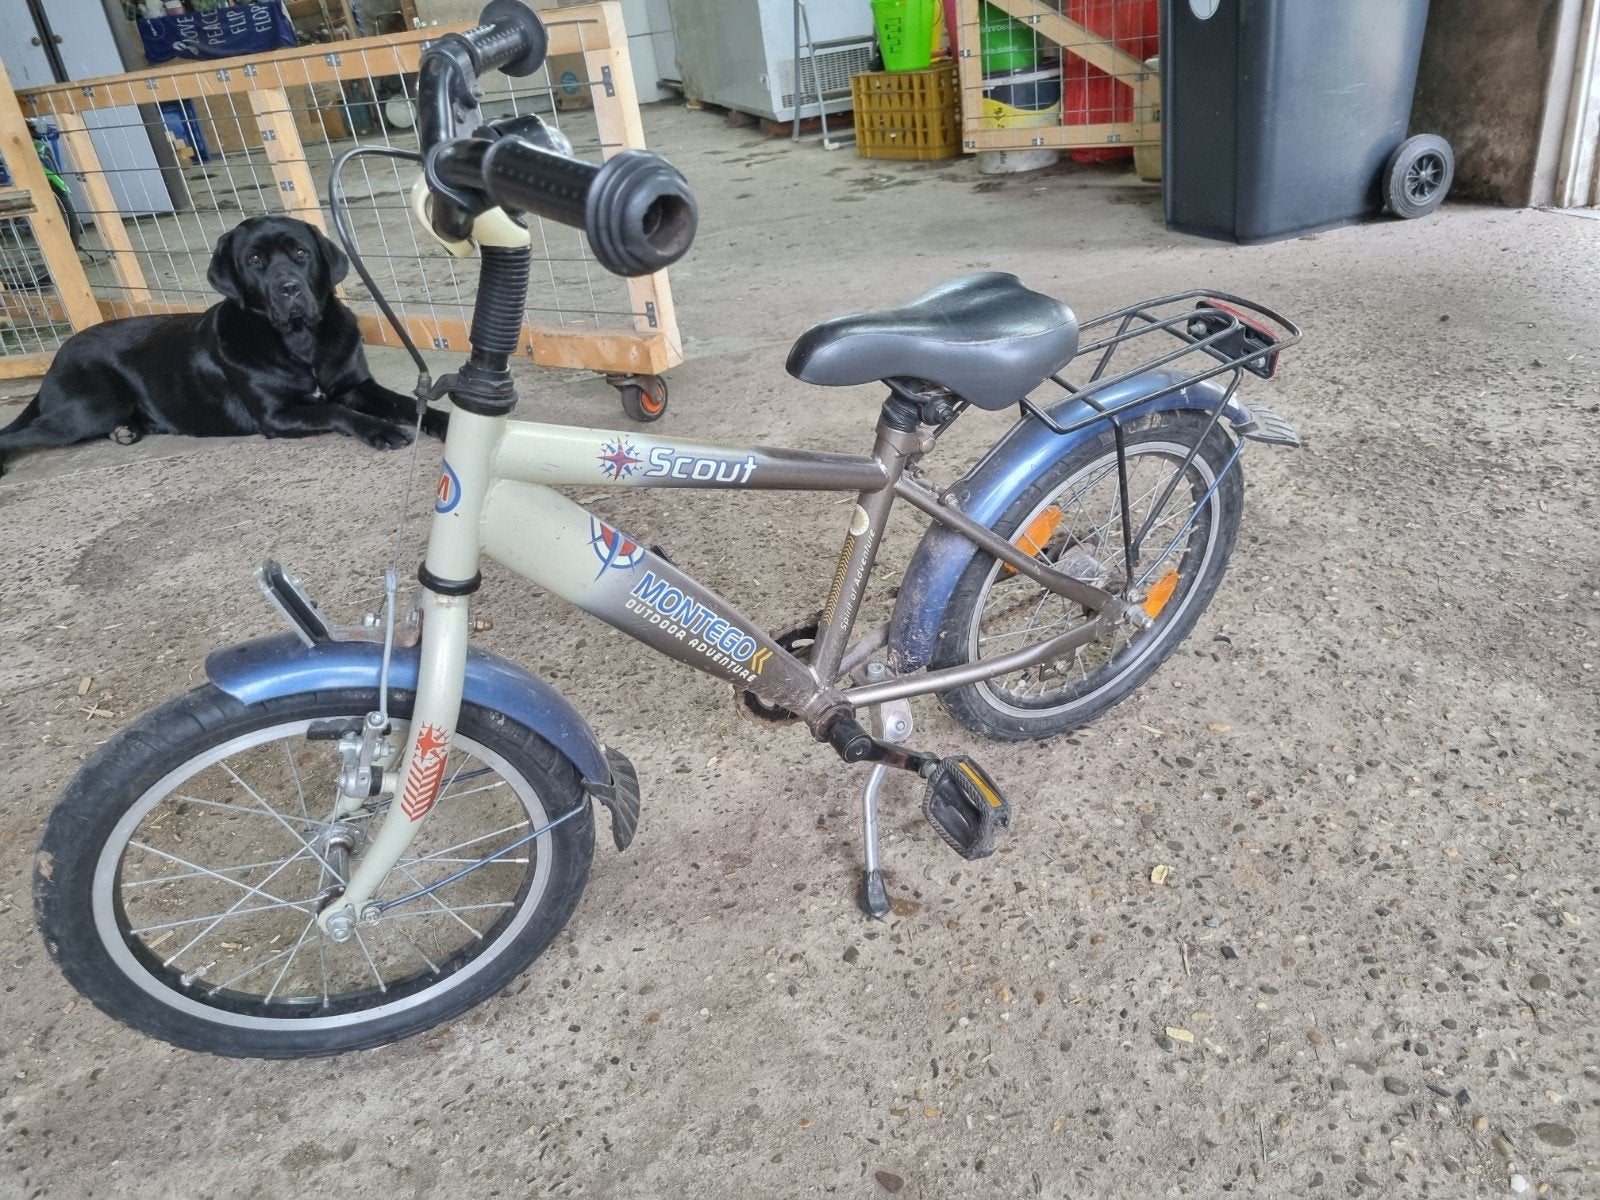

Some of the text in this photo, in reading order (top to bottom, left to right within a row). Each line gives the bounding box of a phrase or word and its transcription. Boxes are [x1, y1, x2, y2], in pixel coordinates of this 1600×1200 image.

[177, 16, 200, 43] LOVE
[201, 9, 227, 45] PEACE
[226, 10, 248, 35] FLIP
[645, 447, 759, 484] Scout
[840, 602, 853, 630] Spirit
[855, 528, 876, 588] Adventure
[631, 570, 757, 662] MONTEGO
[625, 598, 759, 683] OUTDOOR ADVENTURE
